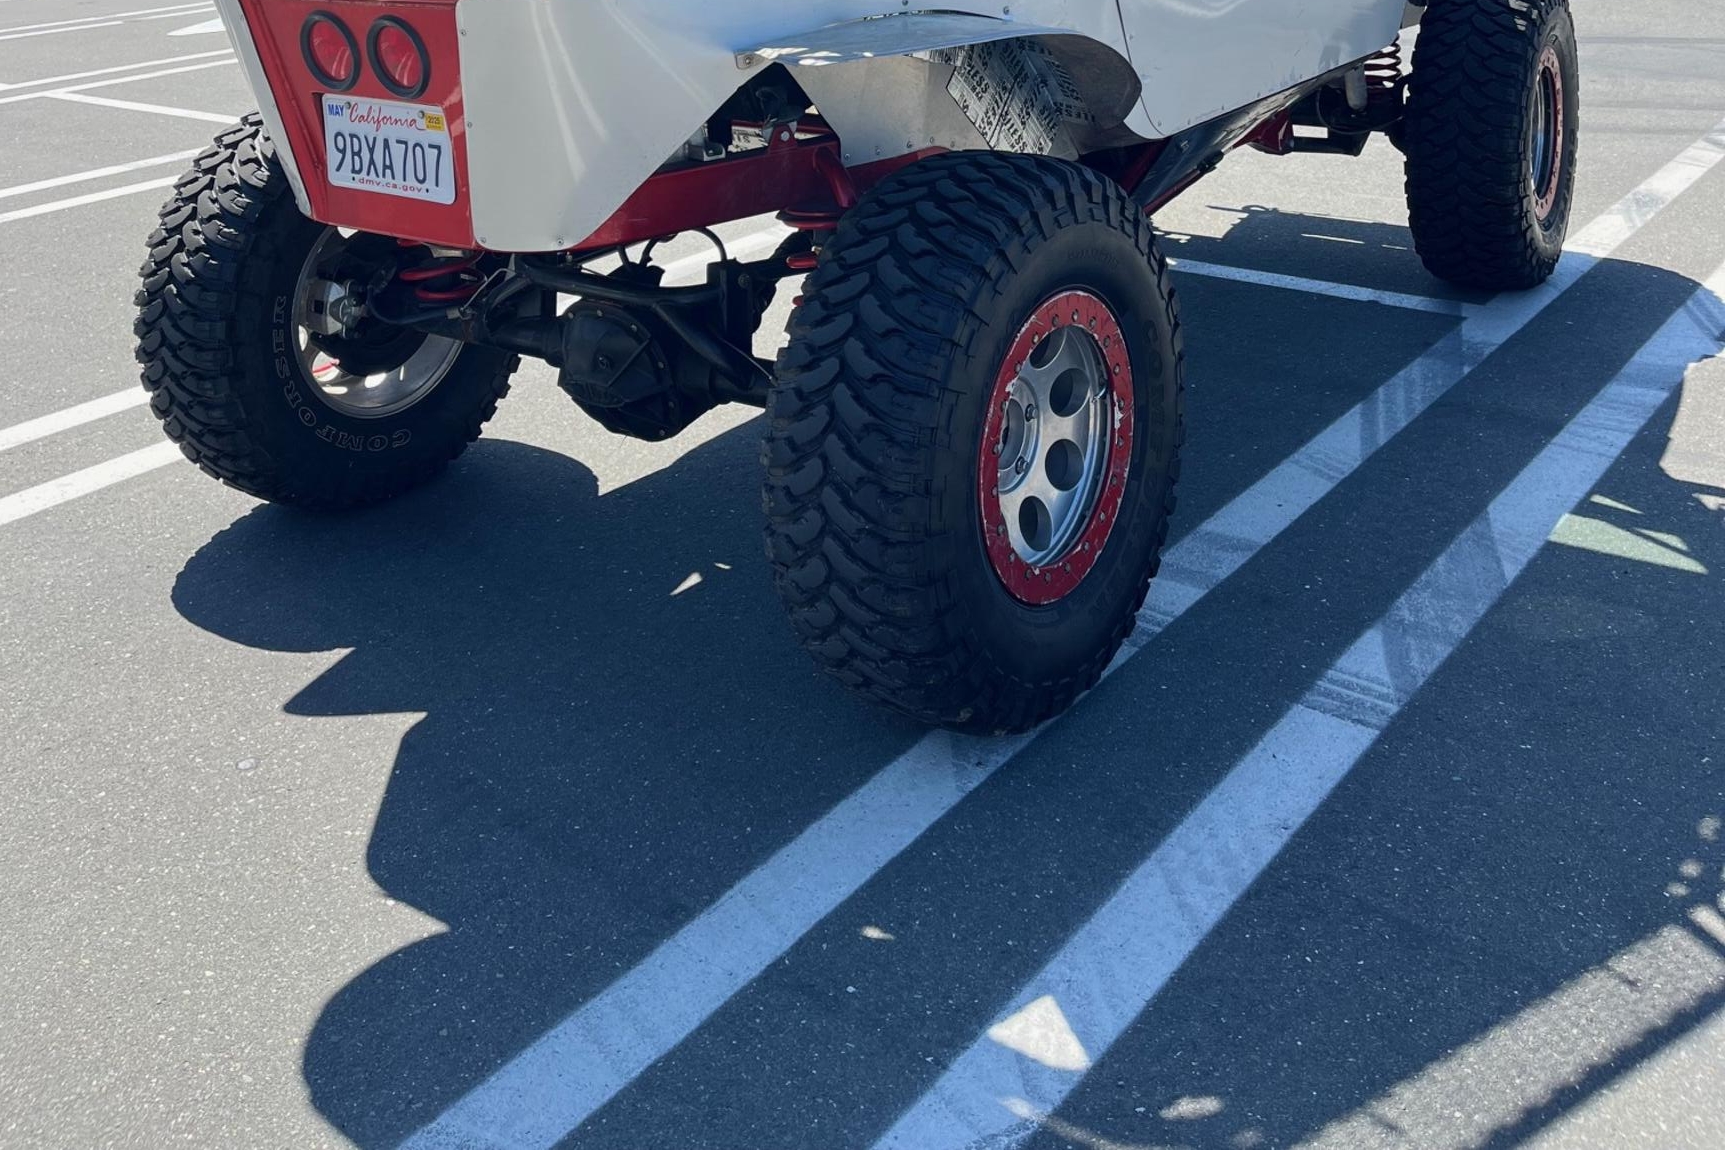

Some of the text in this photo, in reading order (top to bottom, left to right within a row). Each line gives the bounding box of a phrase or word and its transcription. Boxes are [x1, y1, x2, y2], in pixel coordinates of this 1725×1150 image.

[327, 103, 345, 117] MAY
[349, 102, 427, 132] California
[333, 131, 442, 188] 9BXA707
[358, 176, 422, 192] dmv.ca.gov
[273, 295, 412, 451] COMFORSER
